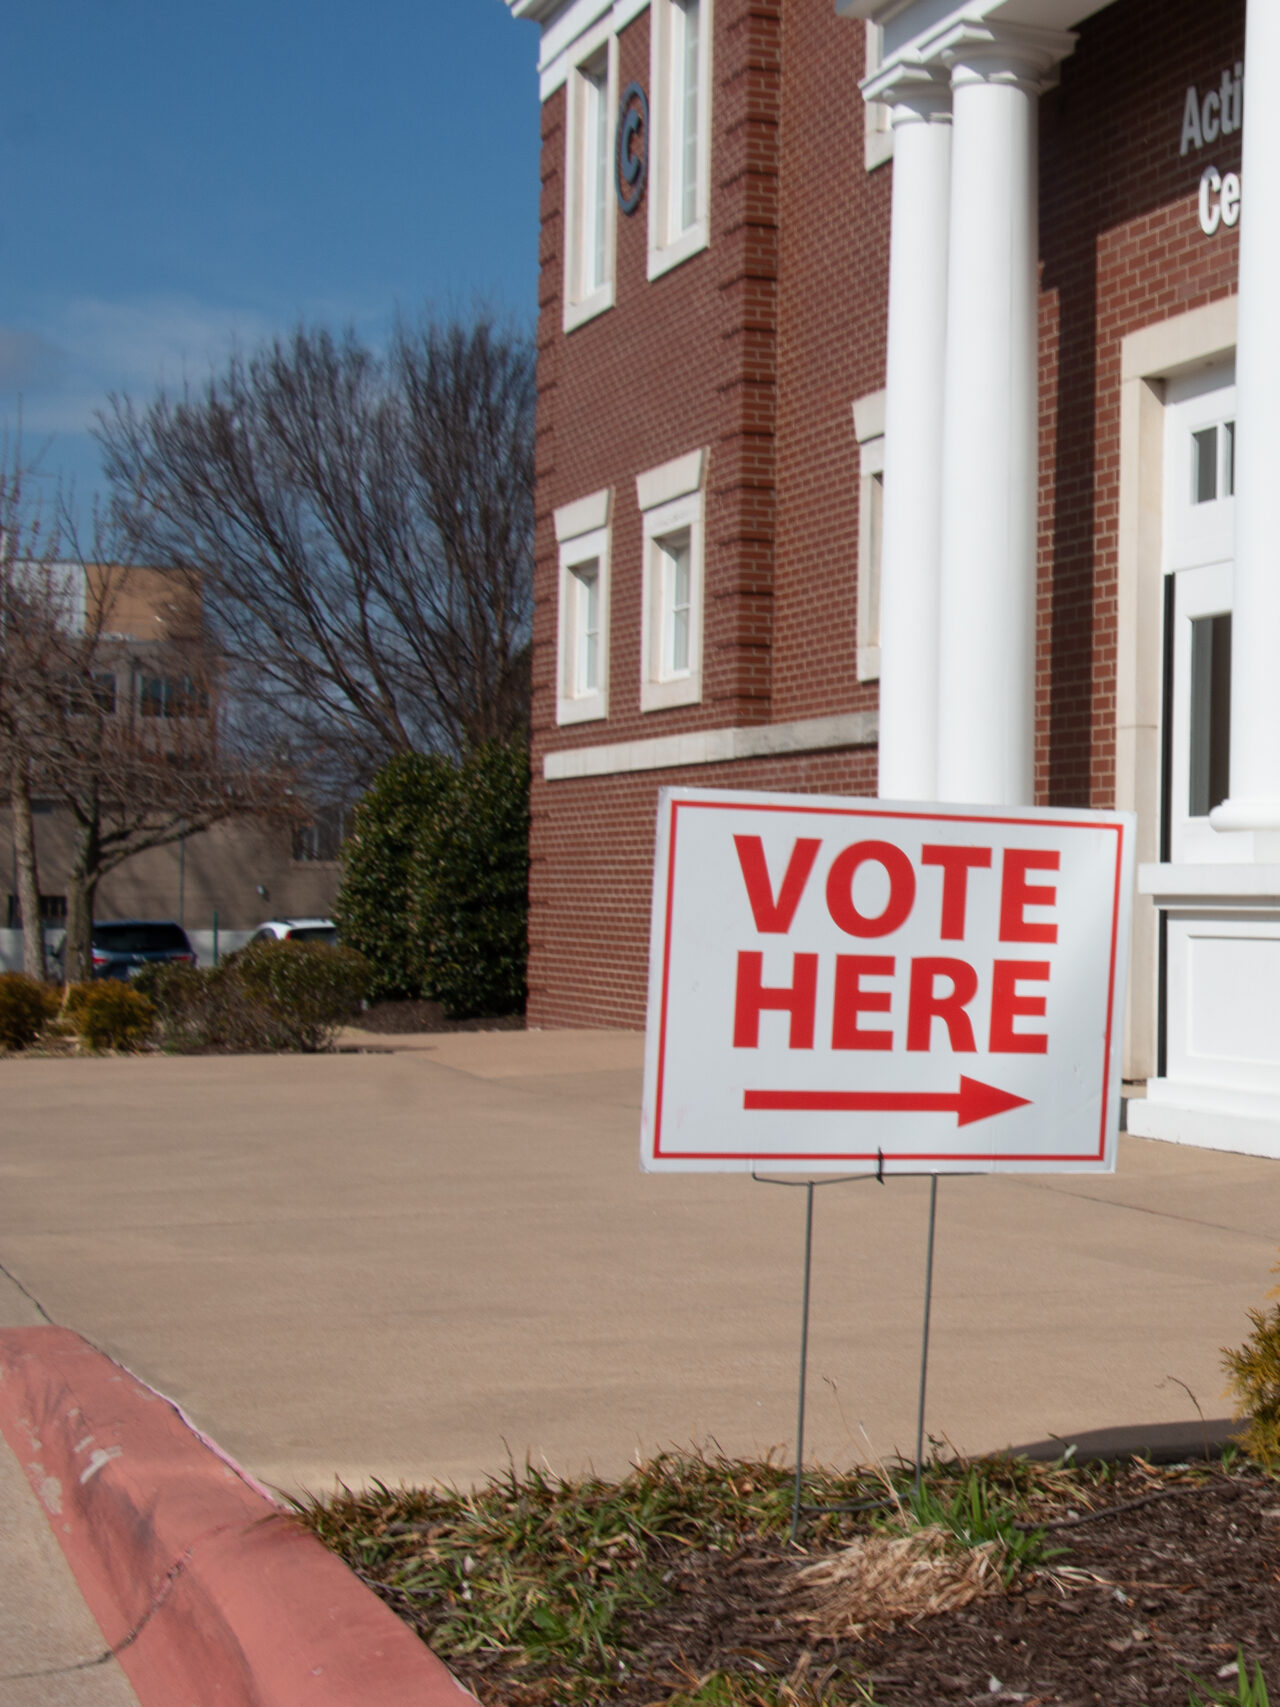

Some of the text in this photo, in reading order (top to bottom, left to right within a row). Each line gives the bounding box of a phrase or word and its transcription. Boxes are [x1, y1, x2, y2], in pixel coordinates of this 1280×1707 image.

[1199, 165, 1240, 236] Ce
[733, 833, 1061, 945] VOTE
[732, 950, 1051, 1055] HERE
